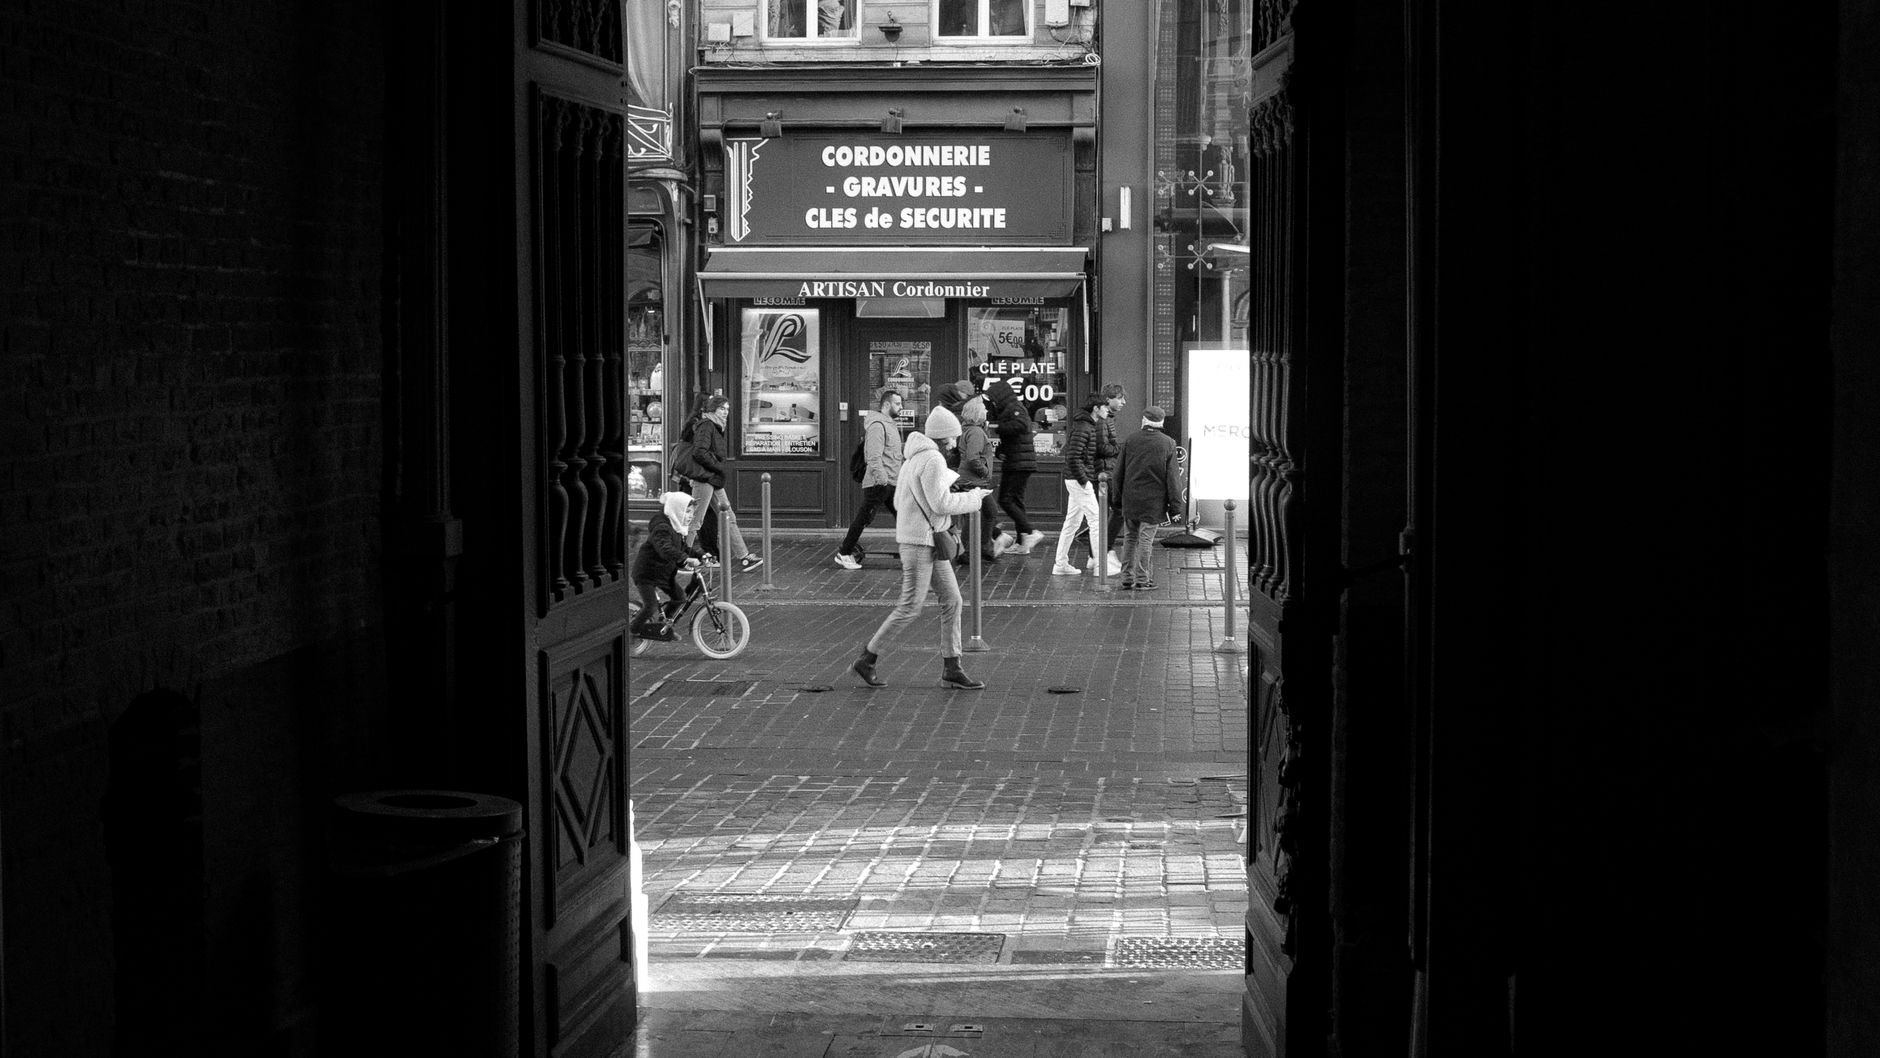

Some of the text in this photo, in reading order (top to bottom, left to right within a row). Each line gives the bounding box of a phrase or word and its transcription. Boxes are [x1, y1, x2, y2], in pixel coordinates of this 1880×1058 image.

[822, 145, 991, 167] CORDONNERIE
[843, 176, 967, 197] GRAVURES
[805, 207, 1007, 229] CLES de SECURITE
[798, 280, 990, 297] ARTISAN Cordonnier
[754, 297, 806, 305] LECOMTE
[991, 296, 1044, 305] LECOMTE
[979, 359, 1056, 374] CLÉ PLATE
